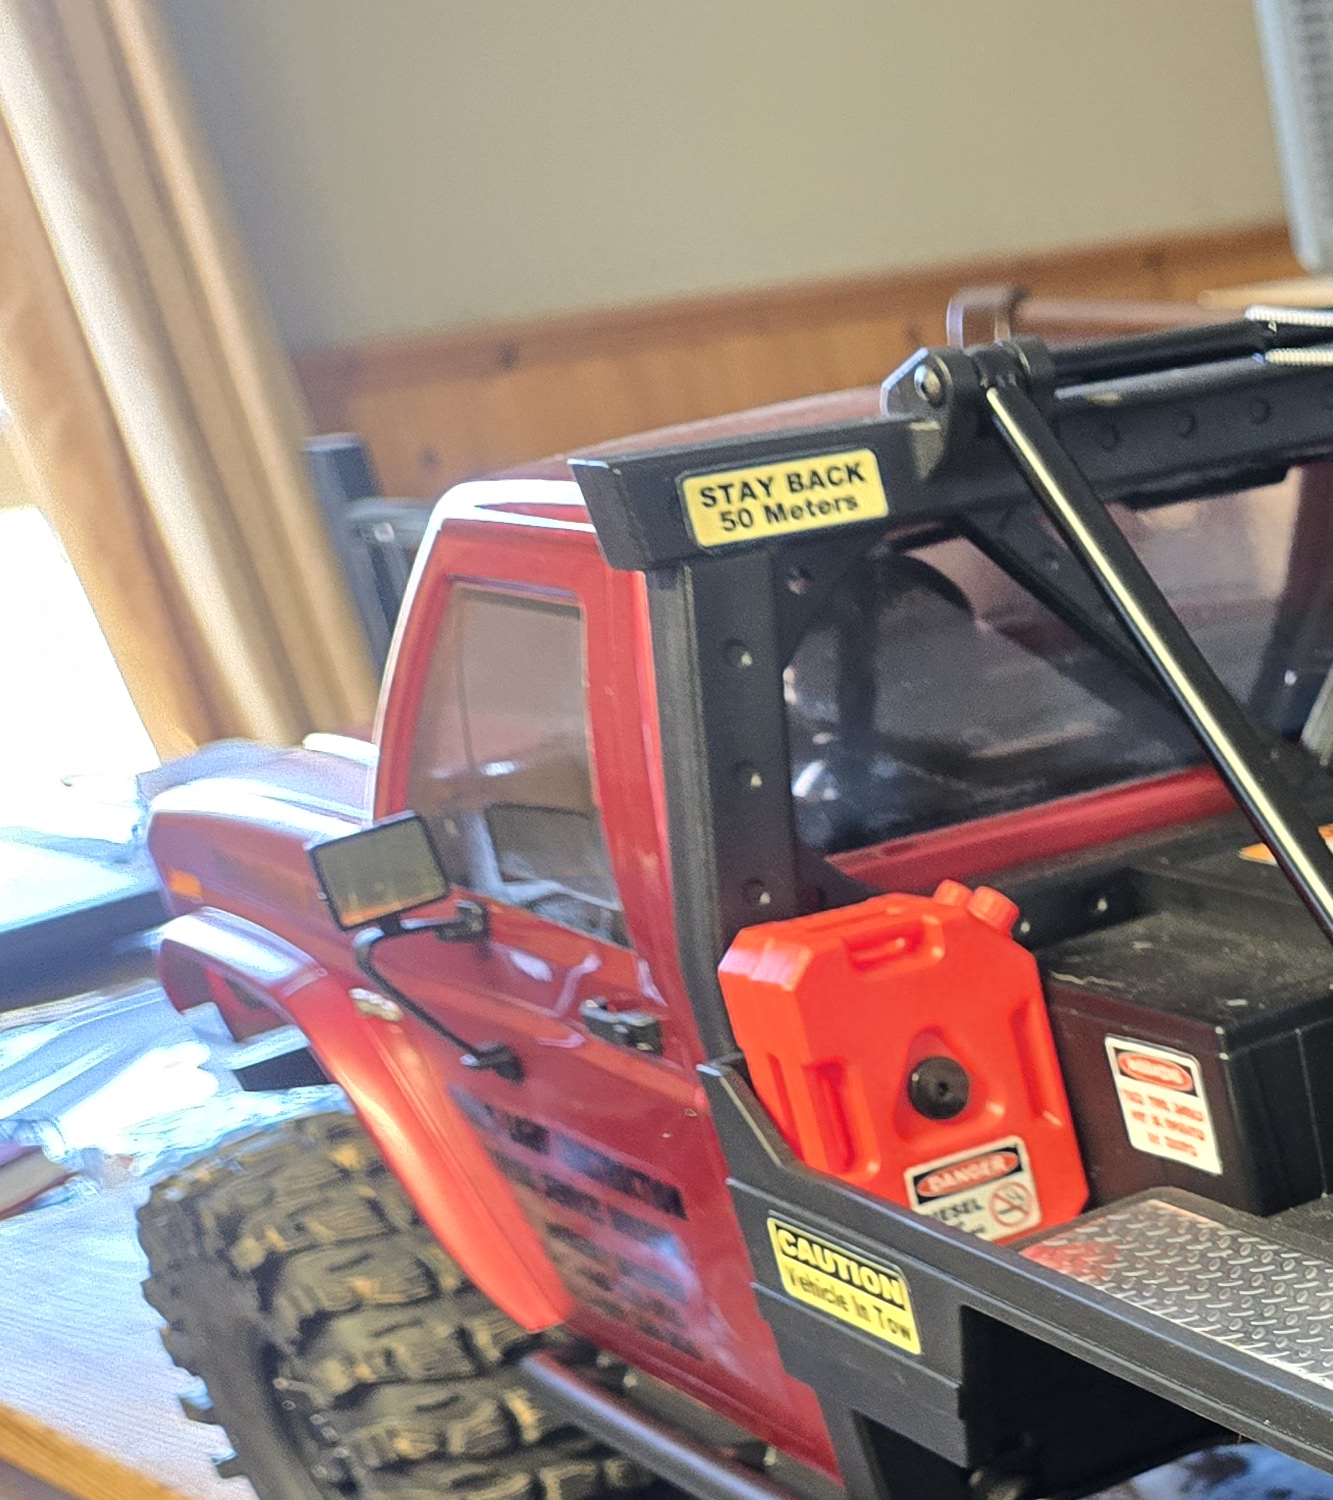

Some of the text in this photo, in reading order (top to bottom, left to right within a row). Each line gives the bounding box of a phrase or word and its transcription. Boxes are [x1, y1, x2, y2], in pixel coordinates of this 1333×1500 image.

[701, 462, 866, 508] STAY BACK
[720, 495, 858, 532] 50 Meters
[927, 1154, 1008, 1194] DANGER
[777, 1228, 904, 1306] CAUTION
[784, 1264, 850, 1313] Vehicle
[873, 1305, 912, 1341] Tow
